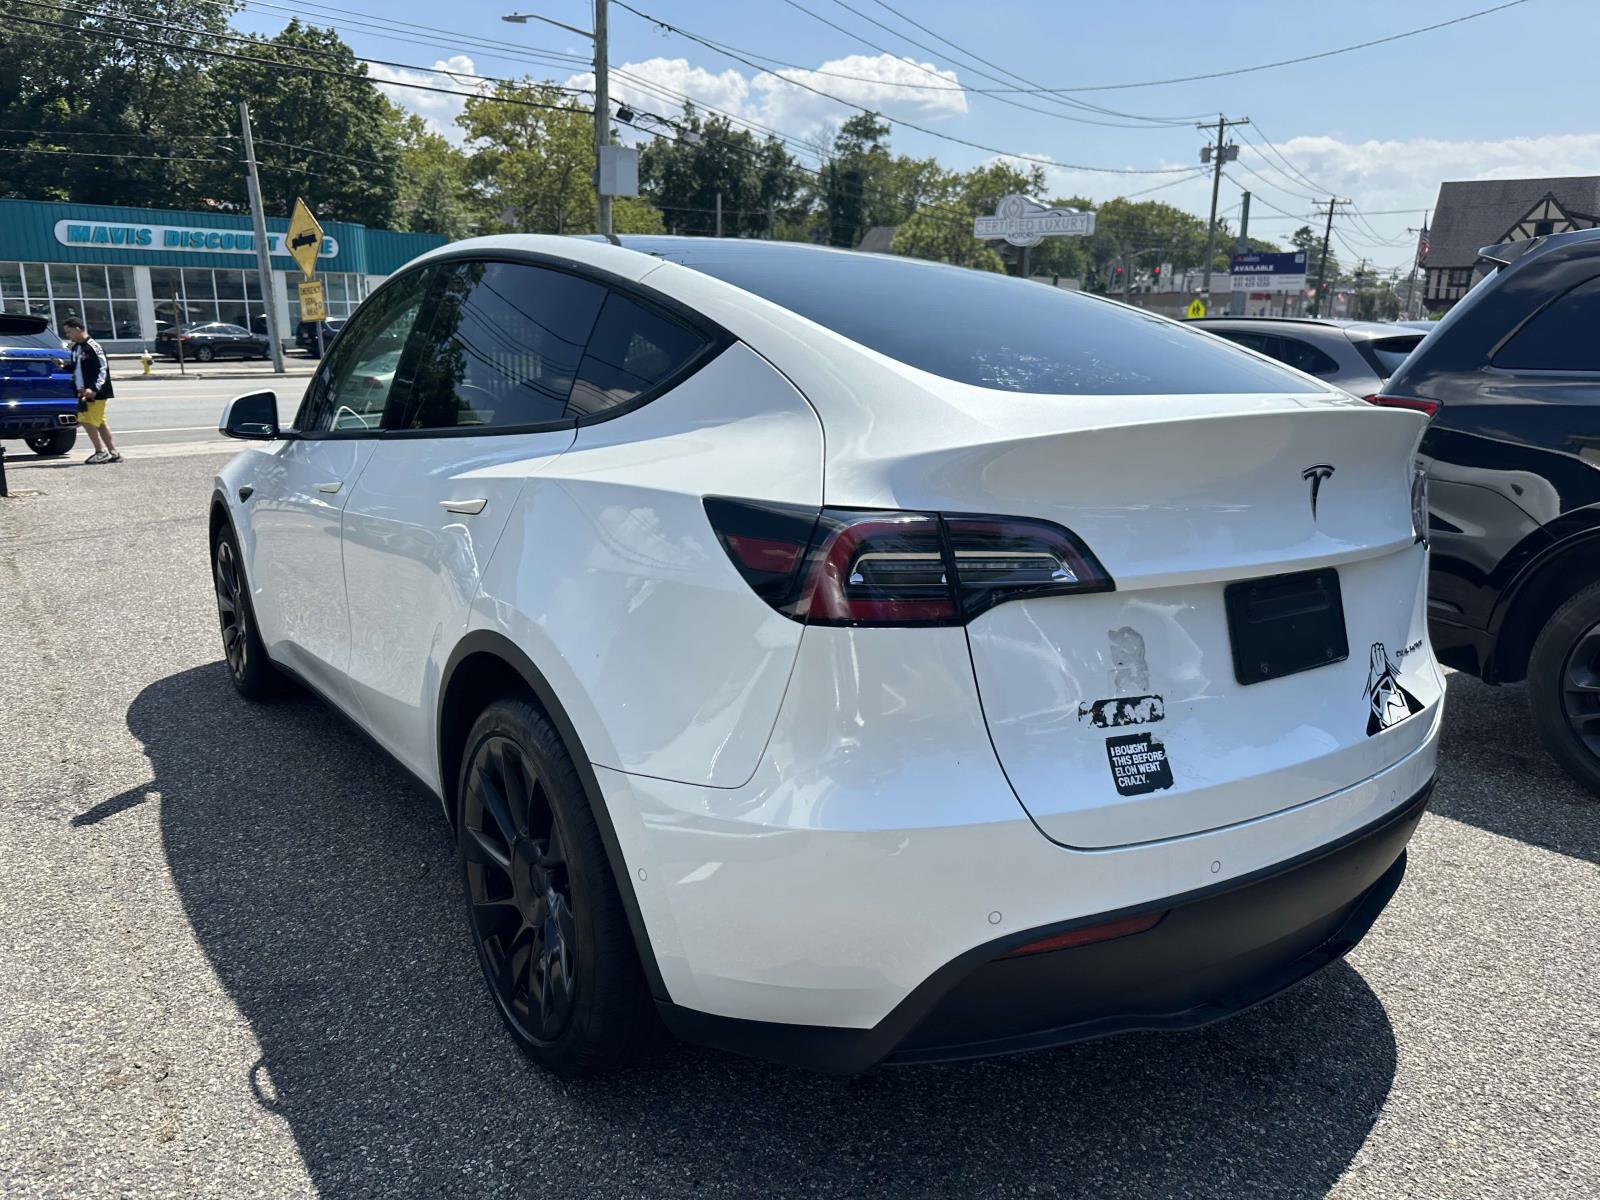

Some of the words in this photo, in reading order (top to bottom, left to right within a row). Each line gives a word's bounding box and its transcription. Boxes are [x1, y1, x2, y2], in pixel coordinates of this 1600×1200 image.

[975, 219, 1033, 233] CERTIFIED
[1039, 217, 1086, 231] LUXURY
[66, 224, 152, 246] MAVIS
[164, 229, 279, 251] DISCOUT
[1234, 264, 1274, 272] AVAILABLE
[1110, 747, 1114, 756] I
[1114, 743, 1147, 756] BOUGHT
[1112, 755, 1132, 766] THIS
[1132, 751, 1164, 764] BEFORE
[1115, 765, 1137, 777] ELON
[1138, 762, 1160, 773] WENT
[1118, 774, 1149, 787] CRAZY.
